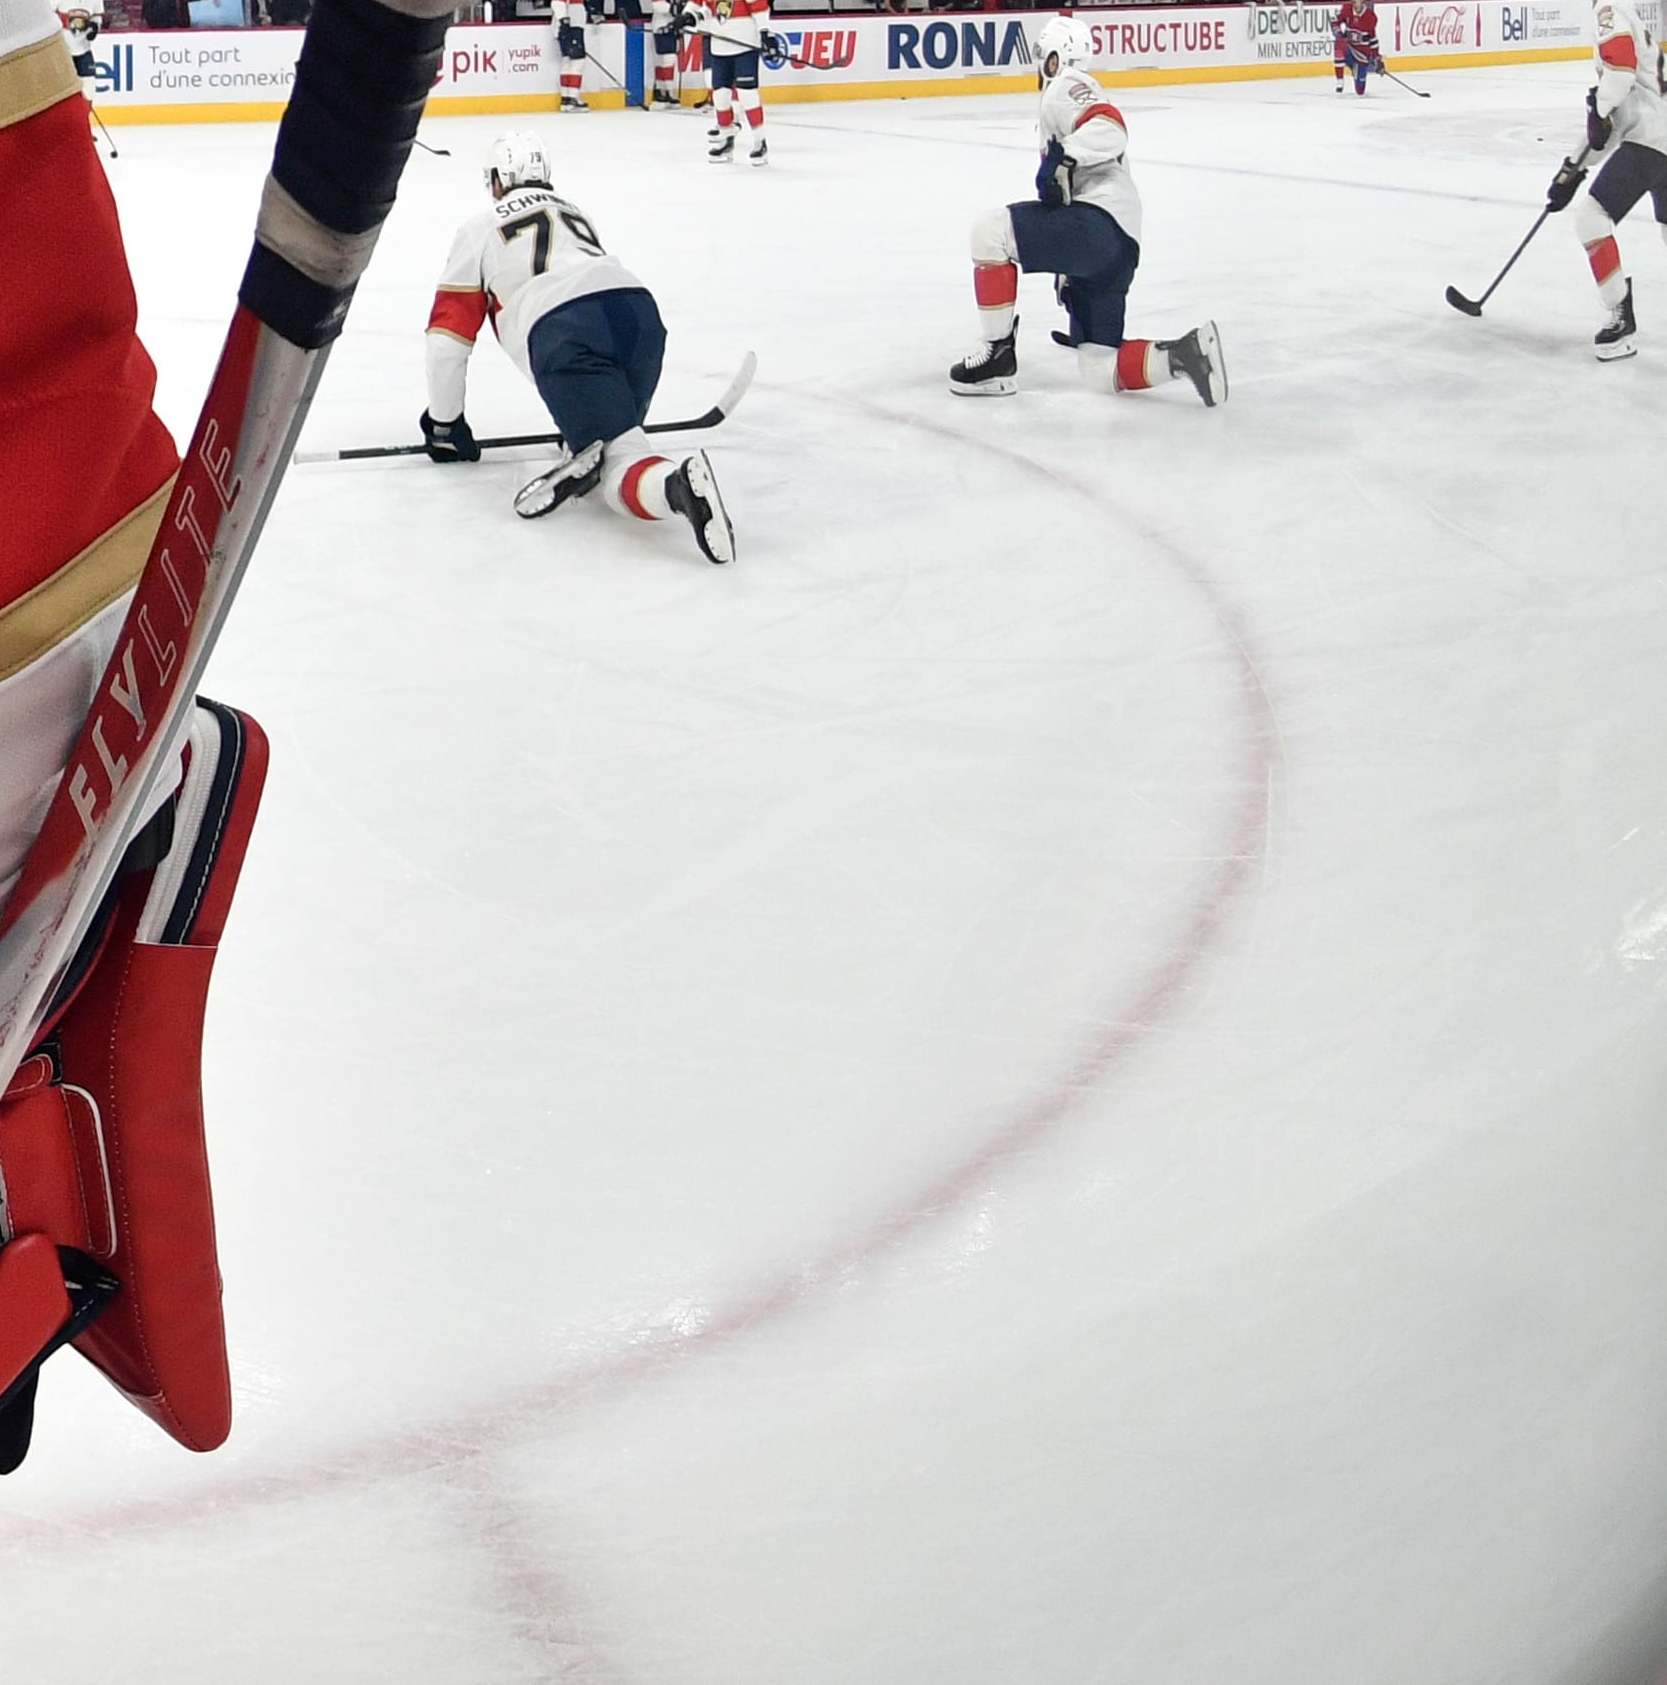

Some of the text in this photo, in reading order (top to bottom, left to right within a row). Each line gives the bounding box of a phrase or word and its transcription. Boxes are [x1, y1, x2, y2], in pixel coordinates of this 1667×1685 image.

[1092, 20, 1226, 56] STRUCTUBE
[1503, 6, 1528, 41] Bell
[149, 45, 240, 67] Tout part
[508, 45, 542, 62] yupik
[790, 30, 857, 70] JEU
[888, 20, 1033, 70] RONA
[1257, 41, 1282, 59] MINI
[150, 69, 296, 89] d'une connexio
[508, 59, 539, 74] .com
[498, 208, 607, 277] 79
[69, 418, 242, 850] FLYLITE
